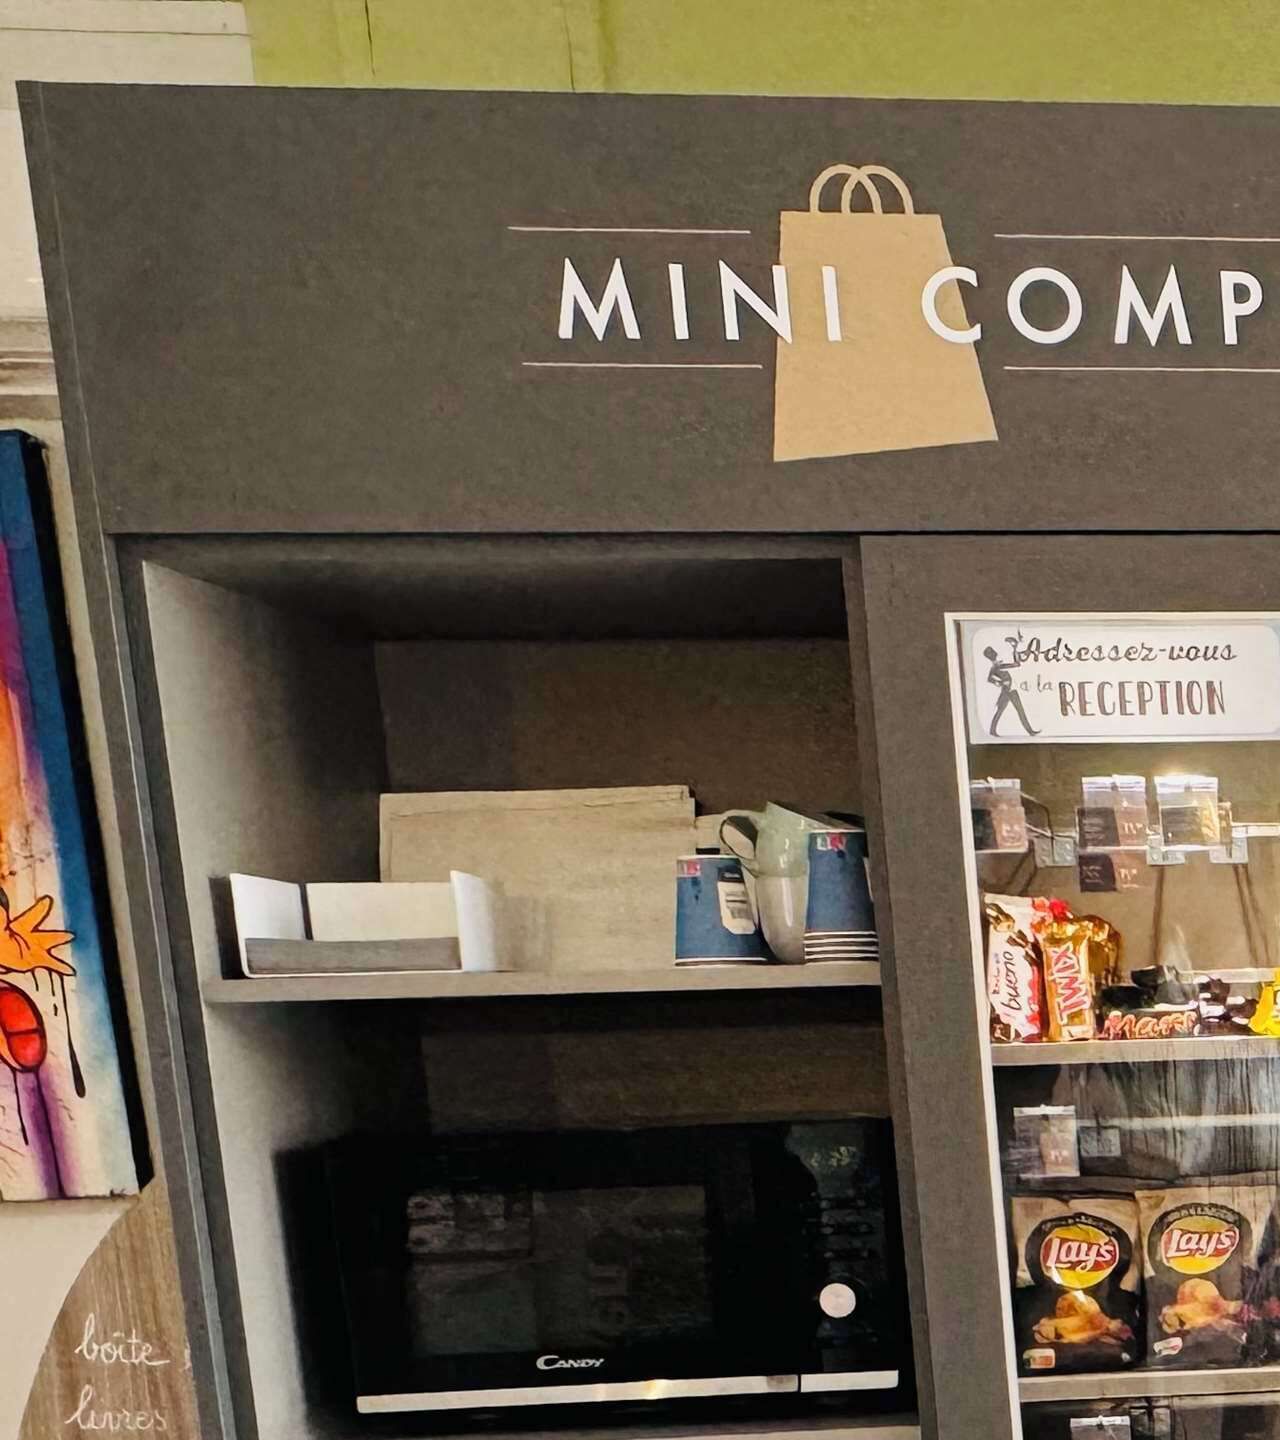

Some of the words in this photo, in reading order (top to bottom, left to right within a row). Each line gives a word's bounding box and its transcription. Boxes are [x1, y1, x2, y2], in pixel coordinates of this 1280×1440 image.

[557, 257, 843, 344] MINI
[1020, 637, 1238, 662] Adressez-vous
[1037, 674, 1054, 692] la
[1058, 680, 1226, 717] RECEPTION
[1001, 951, 1022, 1011] bueno
[1051, 942, 1093, 1025] TWIX
[1045, 1234, 1119, 1273] Lay's
[1165, 1223, 1239, 1259] Lay's
[64, 1384, 168, 1432] livres
